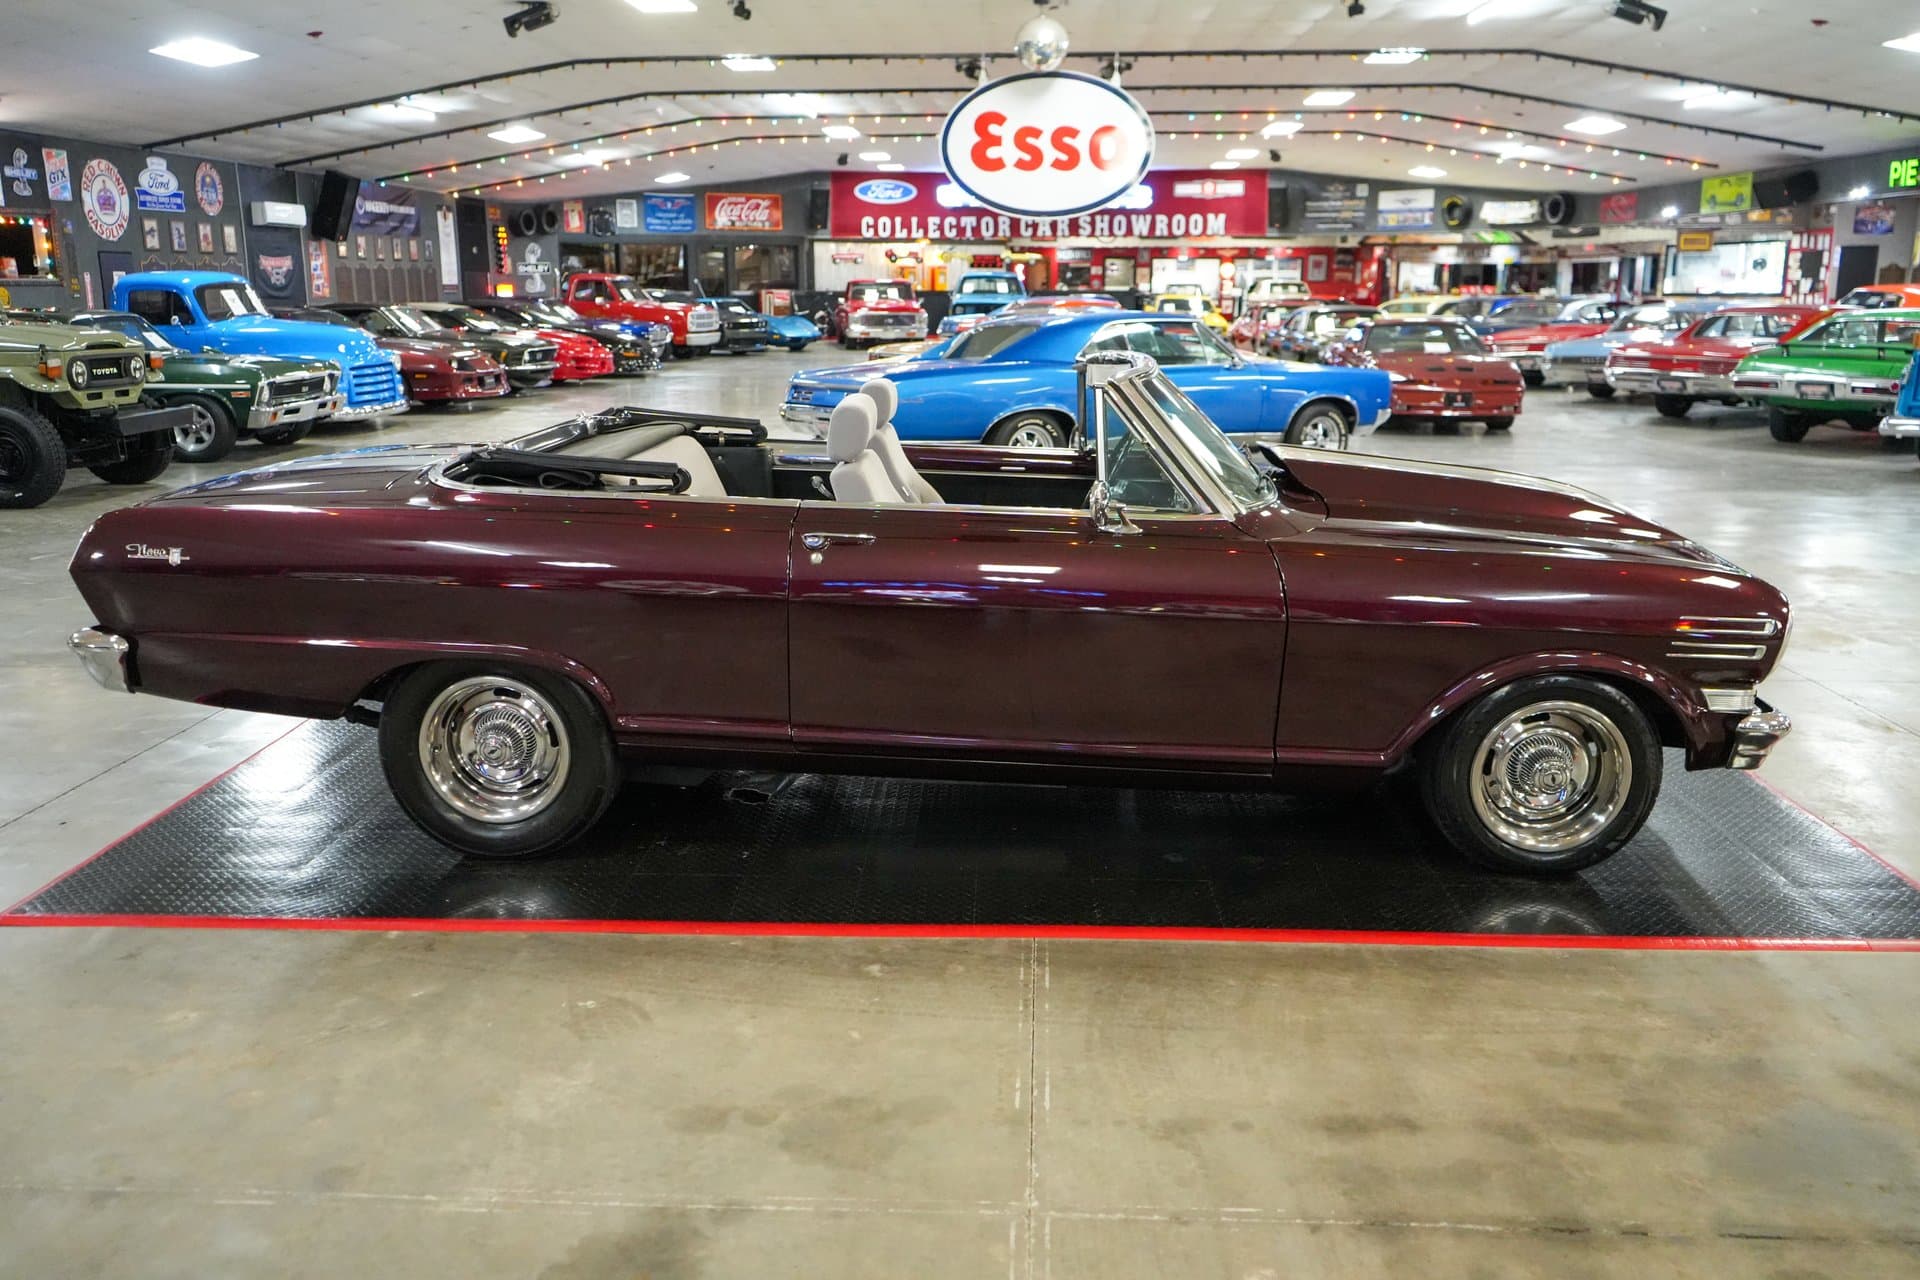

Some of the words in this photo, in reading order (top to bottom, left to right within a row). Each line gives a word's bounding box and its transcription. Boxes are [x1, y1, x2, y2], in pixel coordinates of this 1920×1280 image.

[970, 111, 1128, 172] Esso
[83, 165, 96, 192] RED
[97, 160, 126, 196] CROWN
[147, 172, 171, 190] Ford
[867, 182, 904, 199] Ford
[714, 198, 772, 221] Coca-Cola
[87, 209, 128, 239] GASOLINE
[861, 216, 1011, 240] COLLECTOR
[1019, 217, 1070, 238] CAR
[1078, 213, 1227, 237] SHOWROOM
[92, 367, 118, 376] TOYOTA
